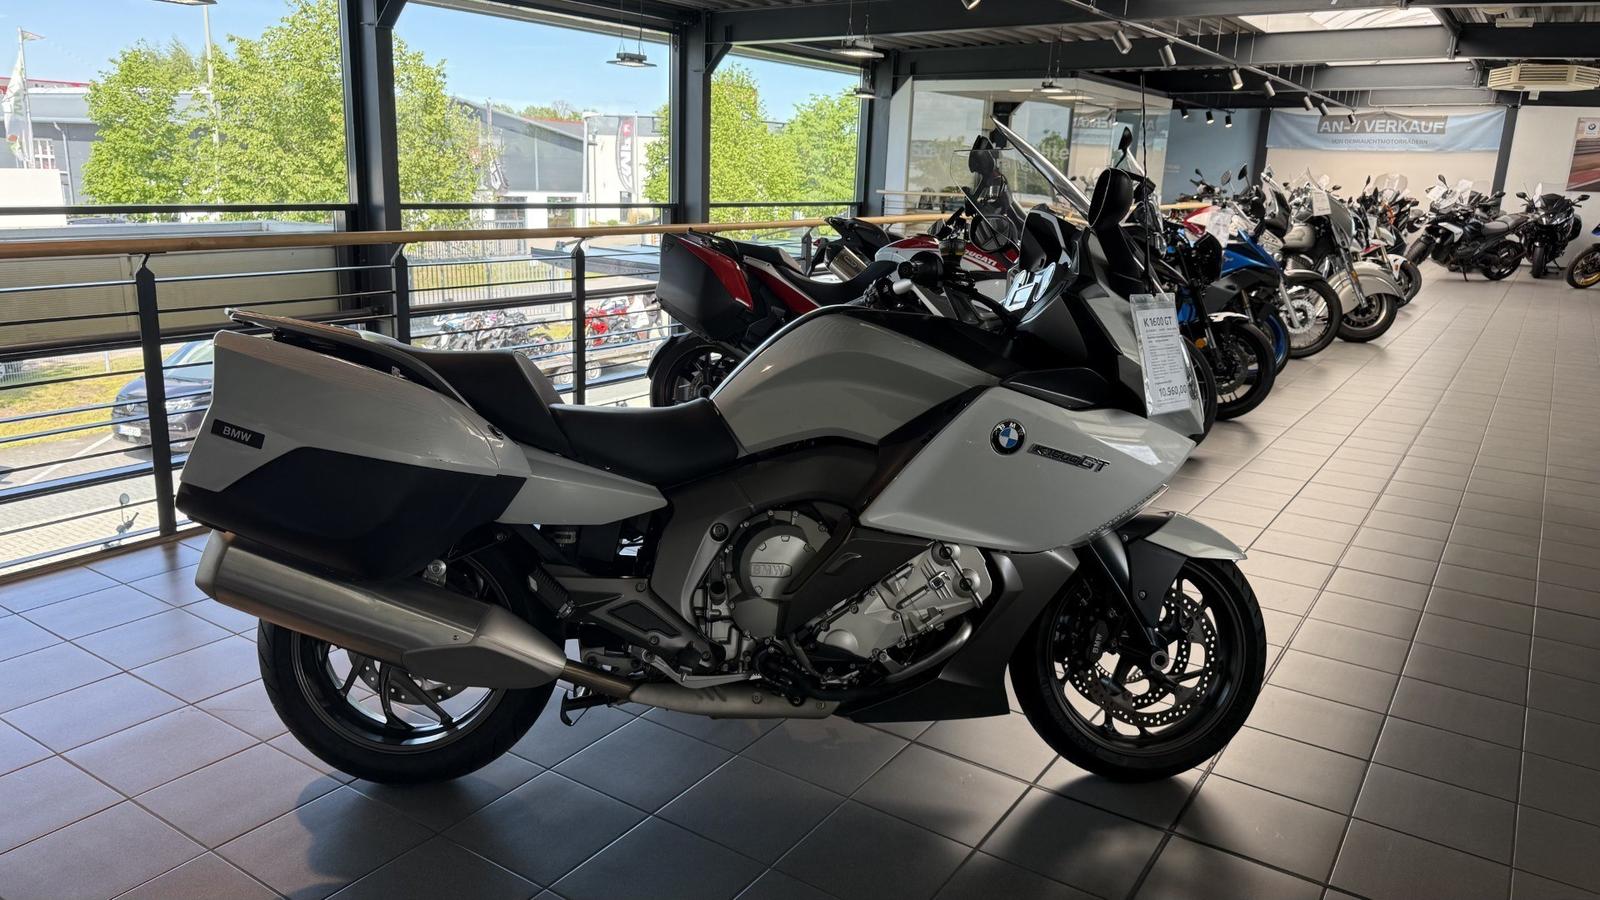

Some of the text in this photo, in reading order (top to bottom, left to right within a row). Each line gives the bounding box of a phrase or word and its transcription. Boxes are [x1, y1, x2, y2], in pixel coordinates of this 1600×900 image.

[1364, 119, 1446, 134] VERKAUF
[223, 426, 252, 442] BMW
[752, 564, 784, 576] BMW
[1092, 633, 1103, 654] BMW
